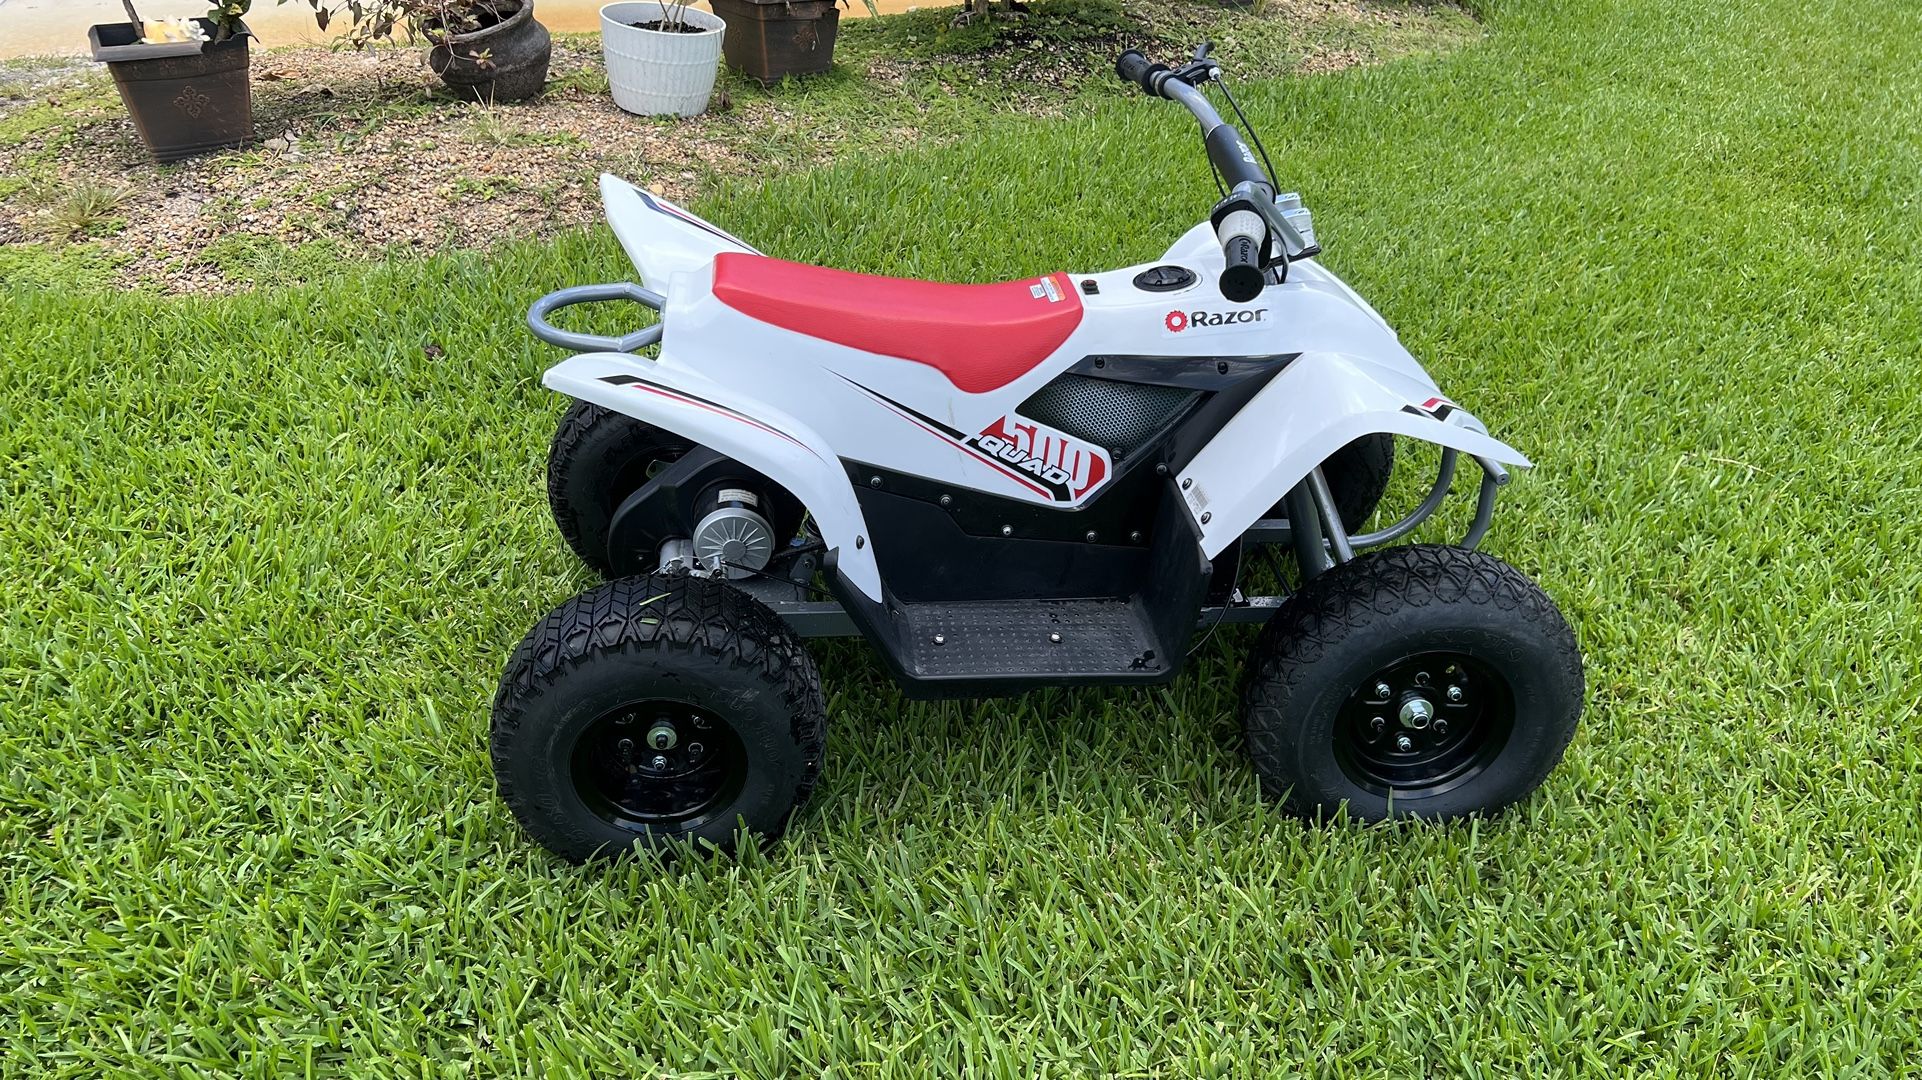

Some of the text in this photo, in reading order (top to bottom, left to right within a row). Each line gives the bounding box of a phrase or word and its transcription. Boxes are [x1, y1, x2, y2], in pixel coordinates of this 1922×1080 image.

[1191, 308, 1269, 328] Razor
[977, 434, 1071, 485] QUAD
[1001, 414, 1092, 491] 500
